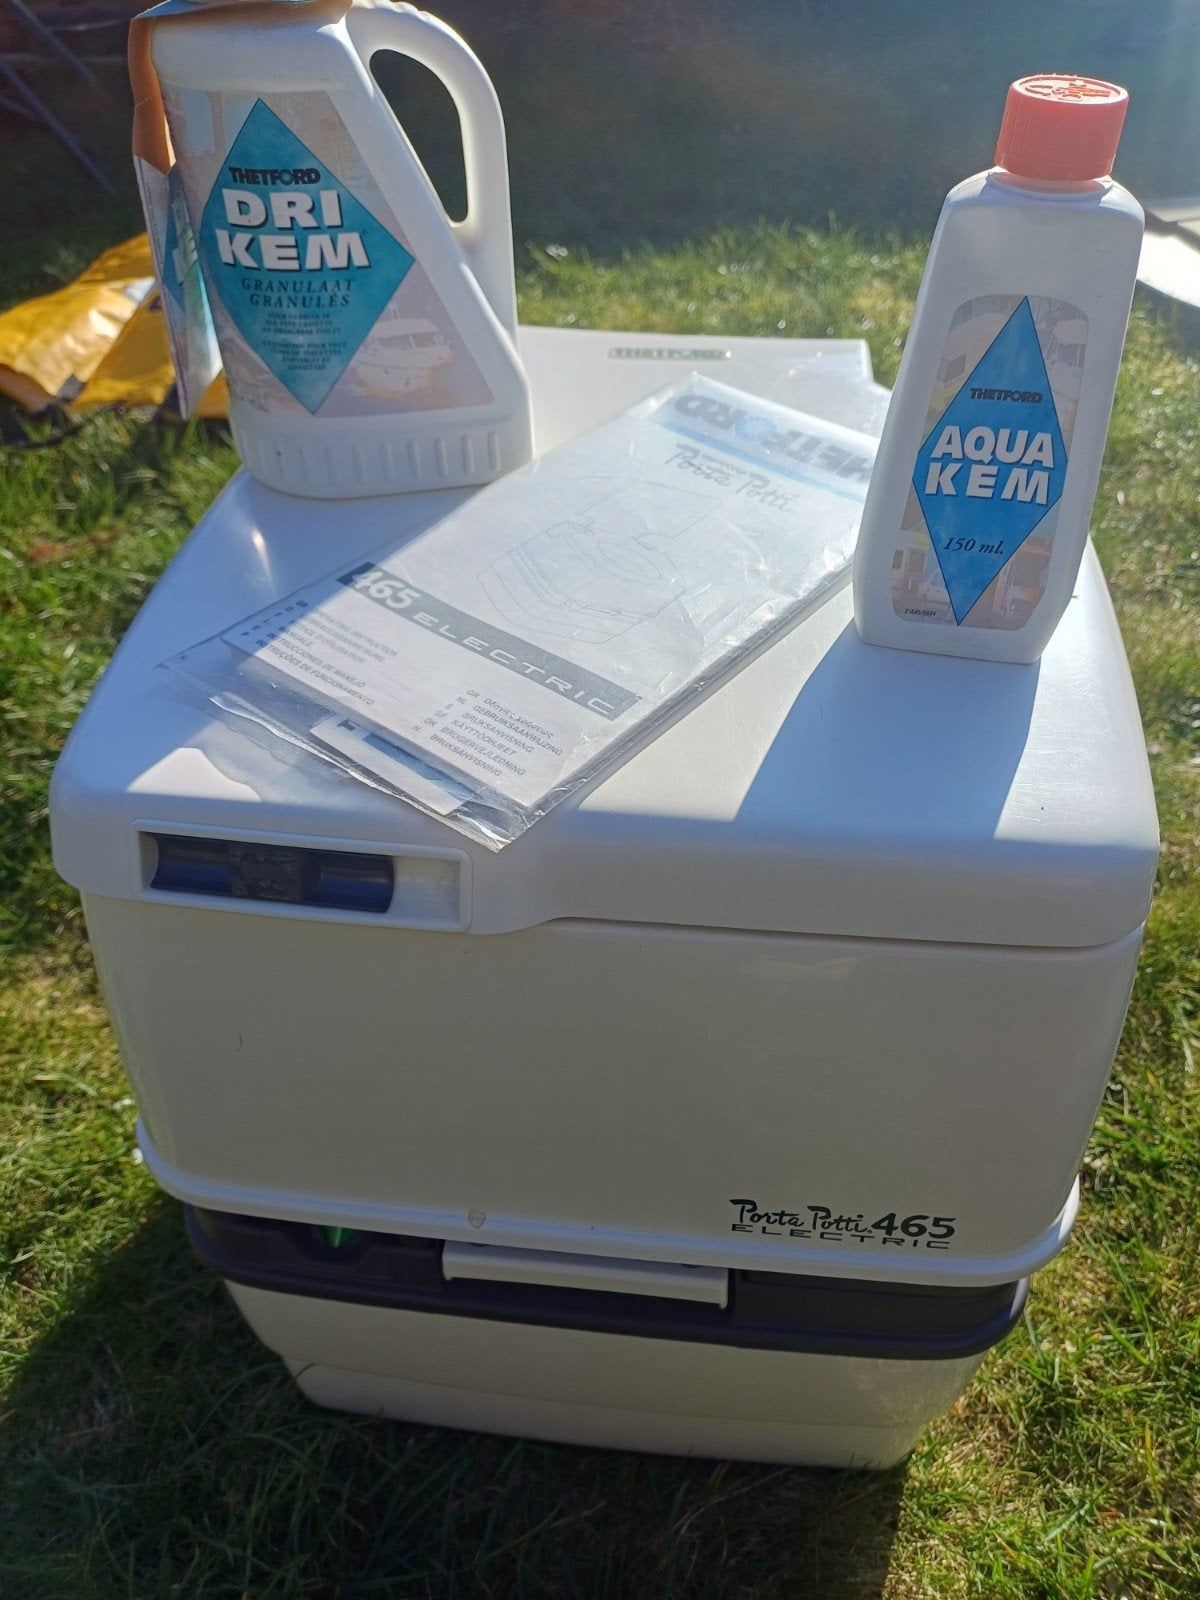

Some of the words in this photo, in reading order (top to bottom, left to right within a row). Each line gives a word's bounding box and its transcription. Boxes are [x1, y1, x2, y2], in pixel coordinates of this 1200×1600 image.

[229, 167, 321, 186] THETFORD
[222, 188, 343, 229] DRI
[215, 229, 371, 271] KEM
[241, 277, 355, 293] GRANULAAT
[970, 387, 1044, 404] THETFORD
[674, 394, 874, 483] HETFORD
[930, 425, 1055, 469] AQUA
[925, 462, 1050, 505] KEM
[943, 536, 976, 552] 150
[979, 539, 1004, 555] ml.
[266, 632, 324, 665] INTRUCCIONES
[352, 570, 421, 609] 465
[412, 611, 617, 715] ELECTRIC
[729, 1198, 805, 1227] Porta
[807, 1205, 867, 1233] Potti
[870, 1212, 957, 1239] 465
[731, 1223, 950, 1250] ELECTRIC
